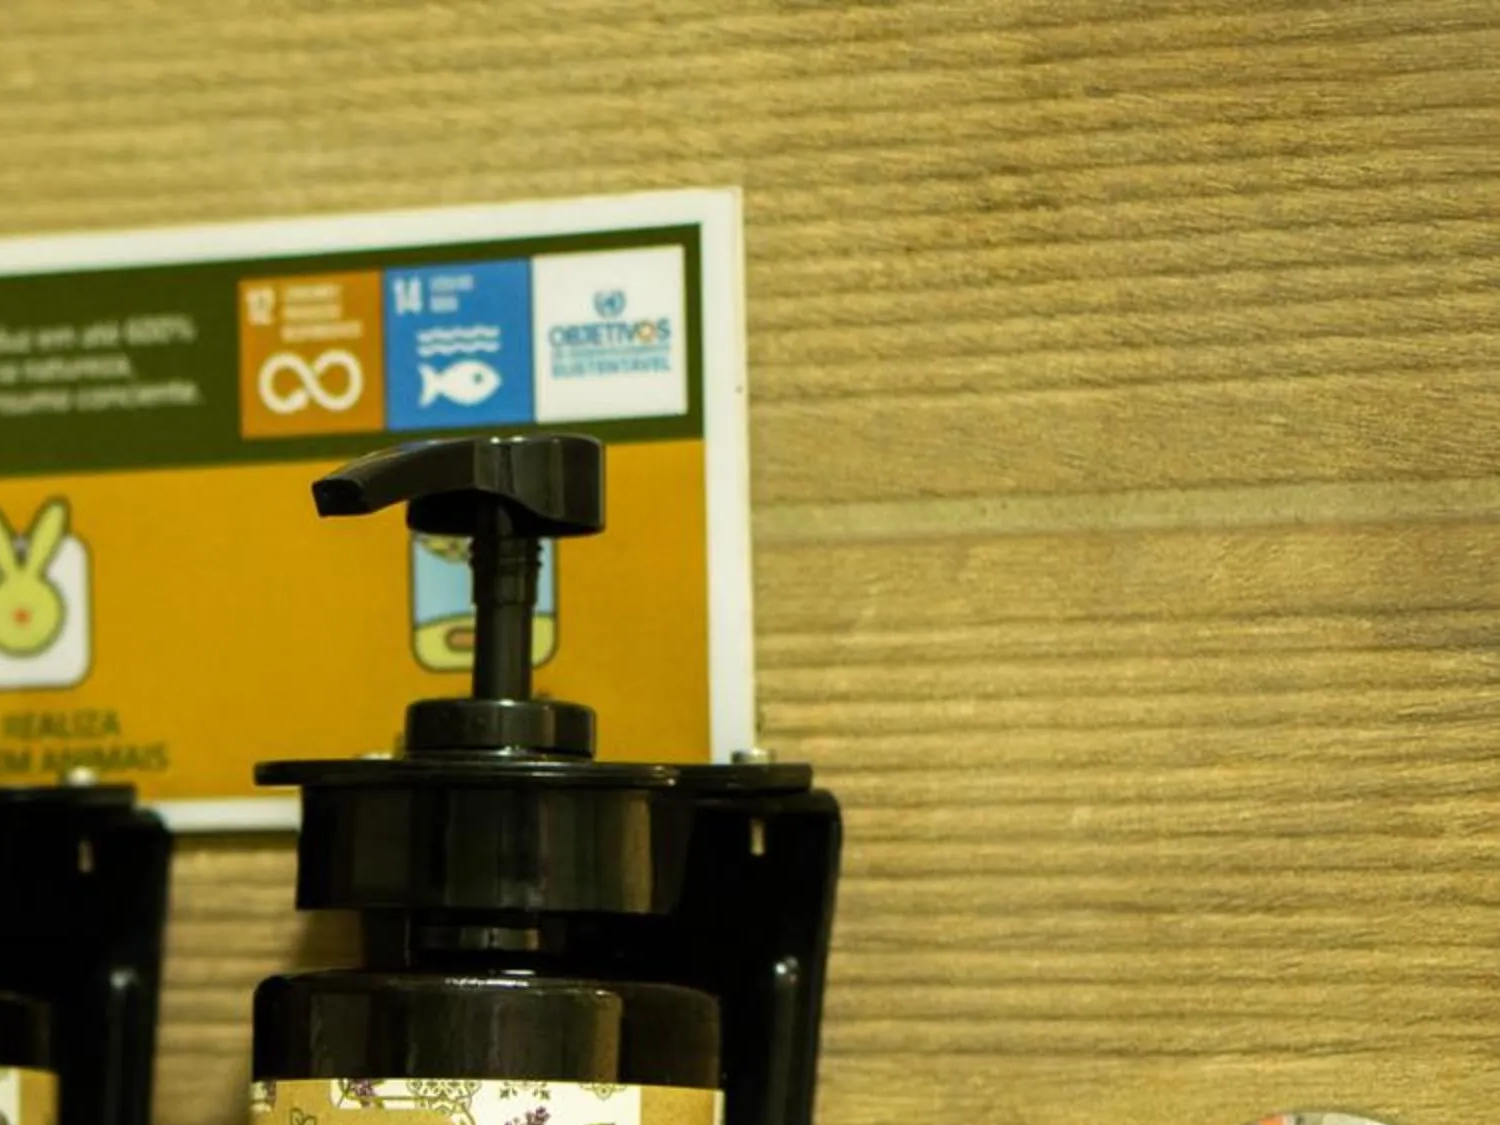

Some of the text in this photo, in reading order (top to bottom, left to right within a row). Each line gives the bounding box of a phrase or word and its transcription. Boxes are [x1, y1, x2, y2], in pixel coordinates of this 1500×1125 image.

[393, 276, 423, 316] 14
[547, 315, 673, 350] OBJETIVOS
[4, 707, 121, 741] REALIZA
